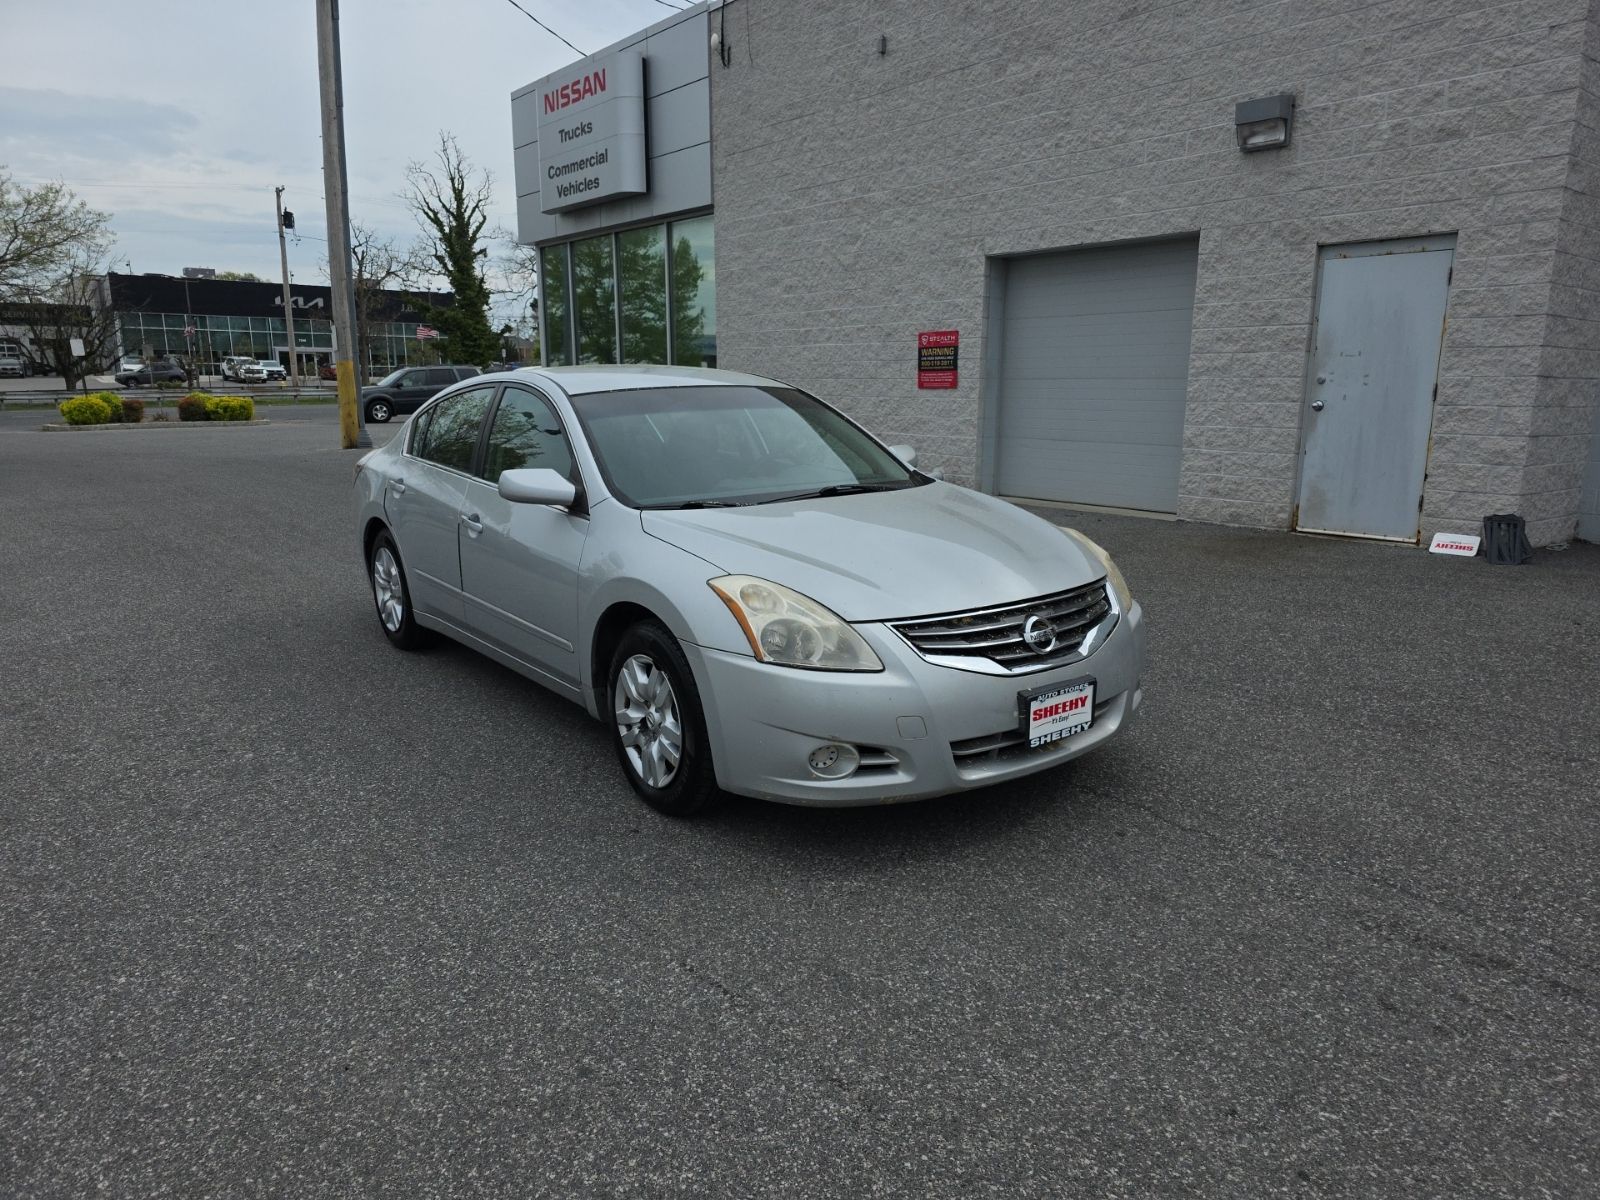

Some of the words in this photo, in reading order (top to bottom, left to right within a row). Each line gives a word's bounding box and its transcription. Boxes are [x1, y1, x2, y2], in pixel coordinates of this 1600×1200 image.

[544, 68, 606, 114] NISSAN
[558, 121, 592, 143] Trucks
[548, 148, 608, 179] Commercial
[556, 177, 600, 198] Vehicles
[921, 347, 955, 356] WARNING
[1435, 543, 1474, 551] SHEEHY
[1037, 691, 1058, 702] AUTO
[1060, 682, 1089, 695] STORES
[1033, 695, 1088, 721] SHEEHY
[1030, 722, 1091, 747] SHEEHY
